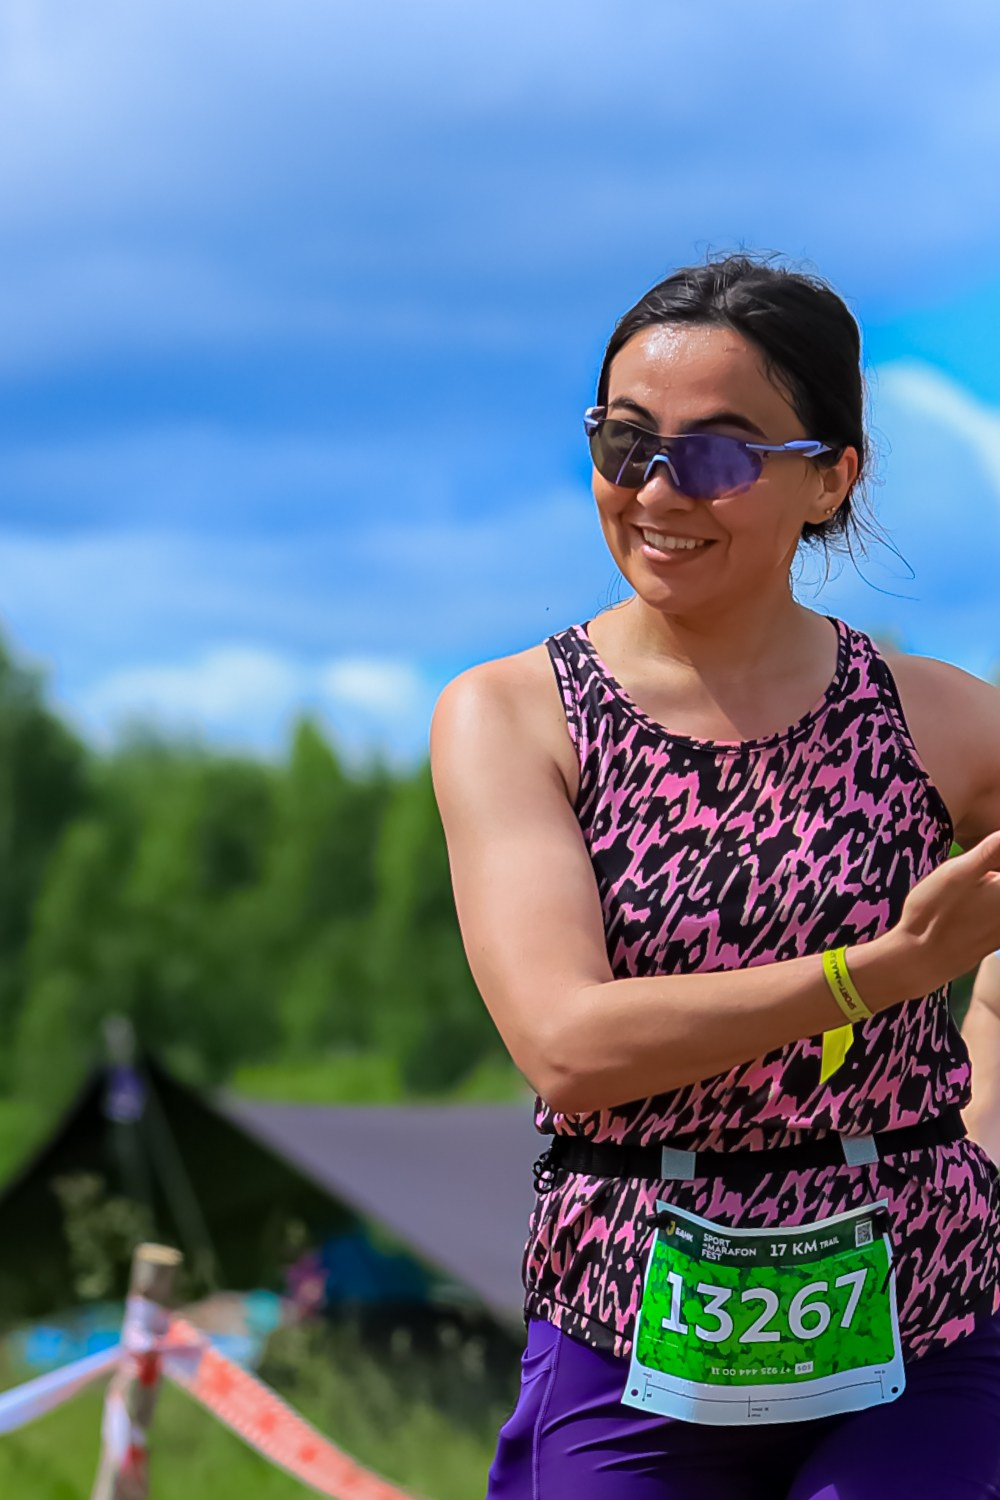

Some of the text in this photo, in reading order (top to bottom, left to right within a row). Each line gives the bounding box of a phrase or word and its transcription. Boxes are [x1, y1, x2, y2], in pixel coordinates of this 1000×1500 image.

[703, 1233, 731, 1247] SPORT
[770, 1243, 787, 1257] 17
[792, 1239, 818, 1255] KM
[820, 1236, 840, 1250] TRAIL
[701, 1249, 722, 1261] FEST
[661, 1268, 868, 1343] 13267
[739, 1367, 758, 1375] 444
[796, 1363, 812, 1373] SOS
